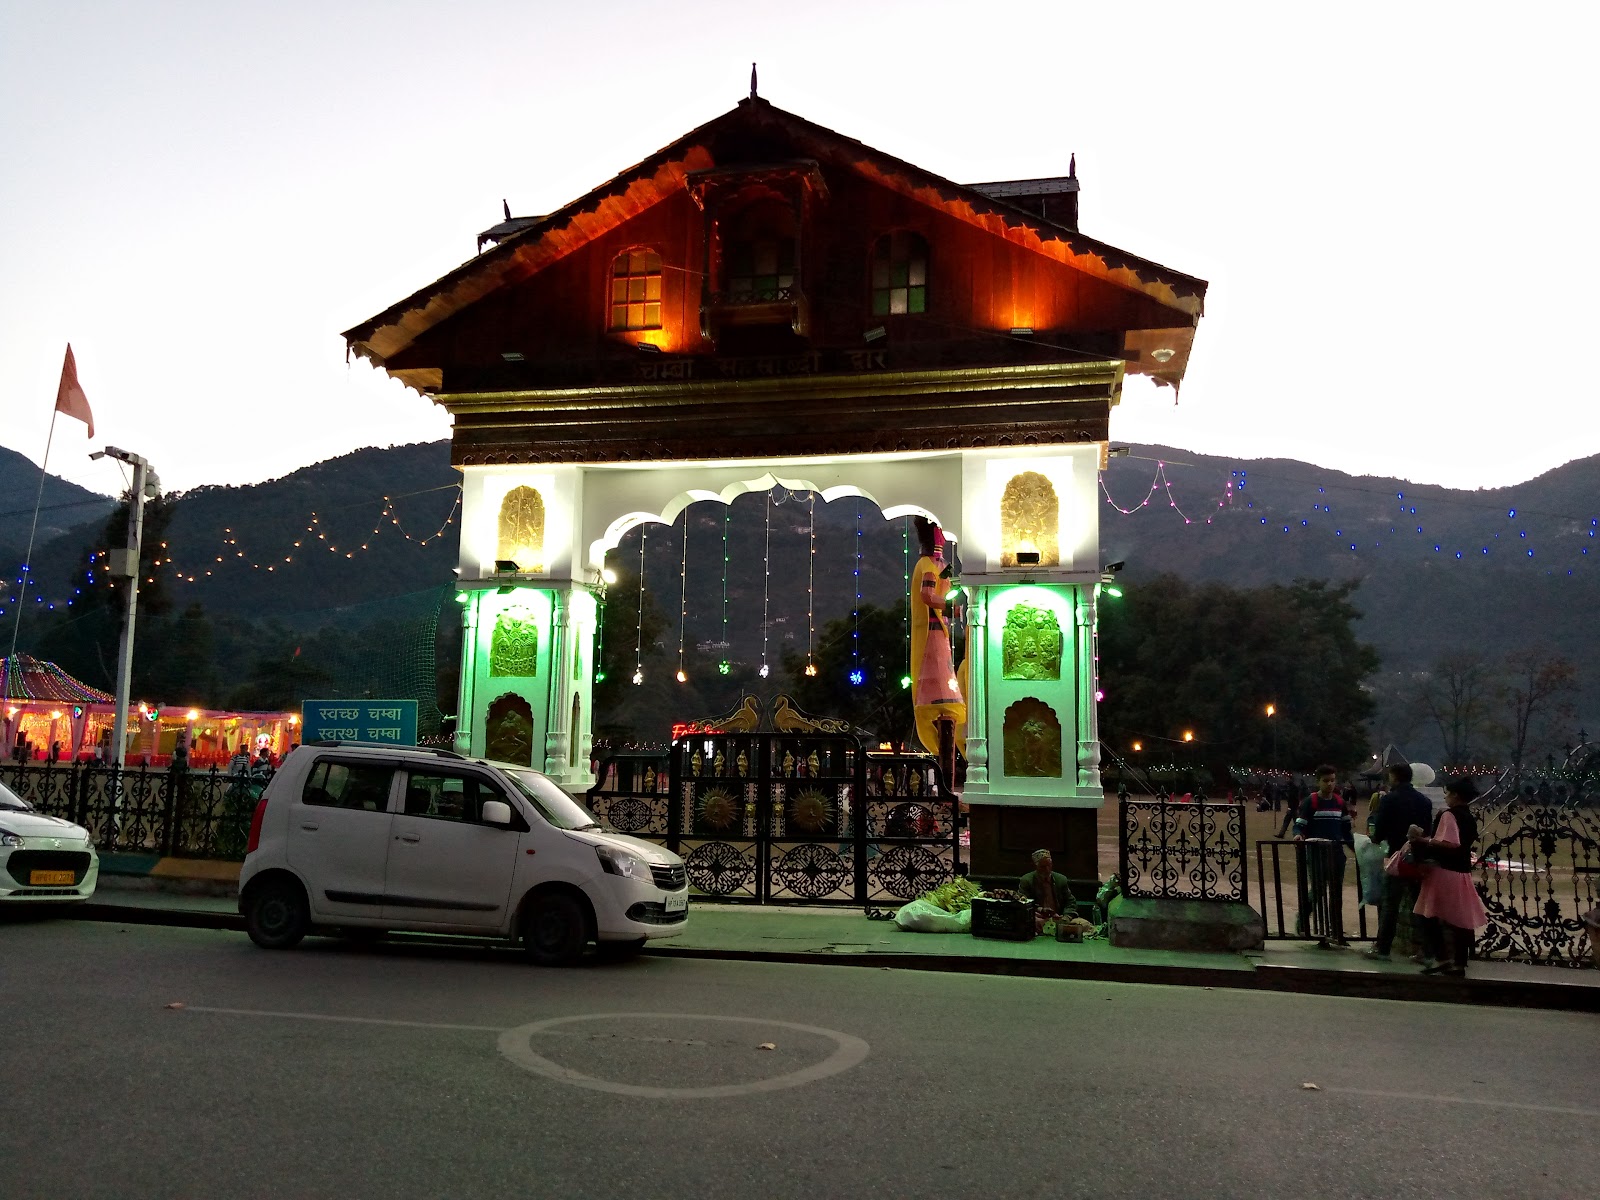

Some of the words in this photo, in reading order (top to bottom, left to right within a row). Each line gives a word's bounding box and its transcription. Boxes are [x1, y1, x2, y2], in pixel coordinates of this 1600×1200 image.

[318, 708, 360, 721] स्वच्छ
[367, 708, 402, 721] चम्बा
[317, 728, 360, 741] स्वस्थ
[367, 727, 402, 740] चम्बा
